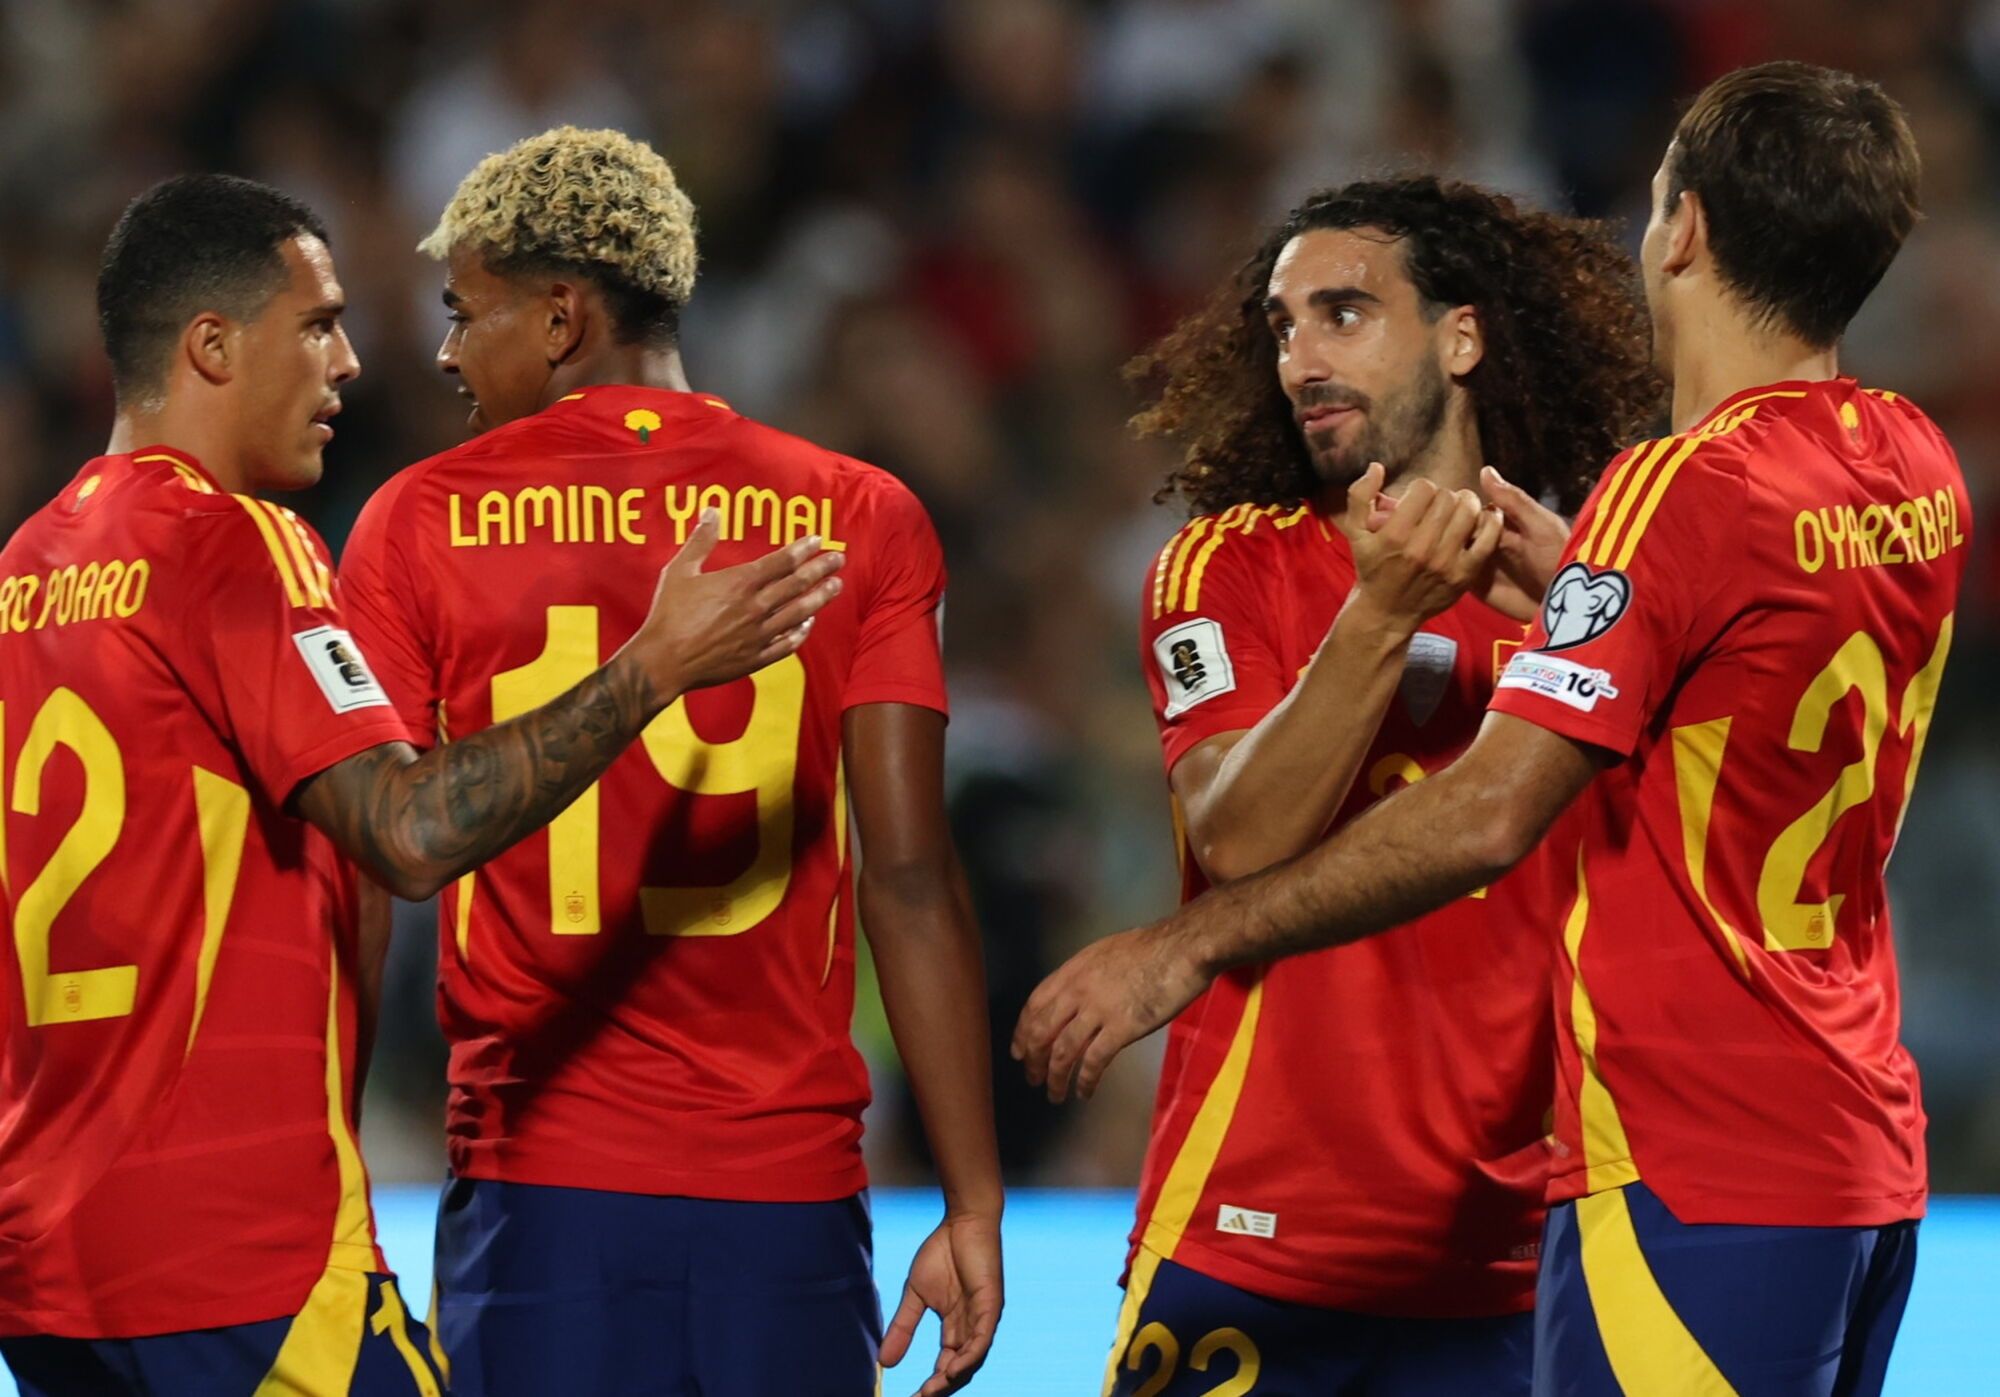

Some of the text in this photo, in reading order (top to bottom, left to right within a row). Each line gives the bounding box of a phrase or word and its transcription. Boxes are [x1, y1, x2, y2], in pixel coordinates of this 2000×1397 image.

[450, 483, 847, 552] LAMINE YAMAL
[1794, 484, 1964, 574] OYARZABAL
[0, 685, 139, 1027] 2
[491, 604, 806, 937] 19
